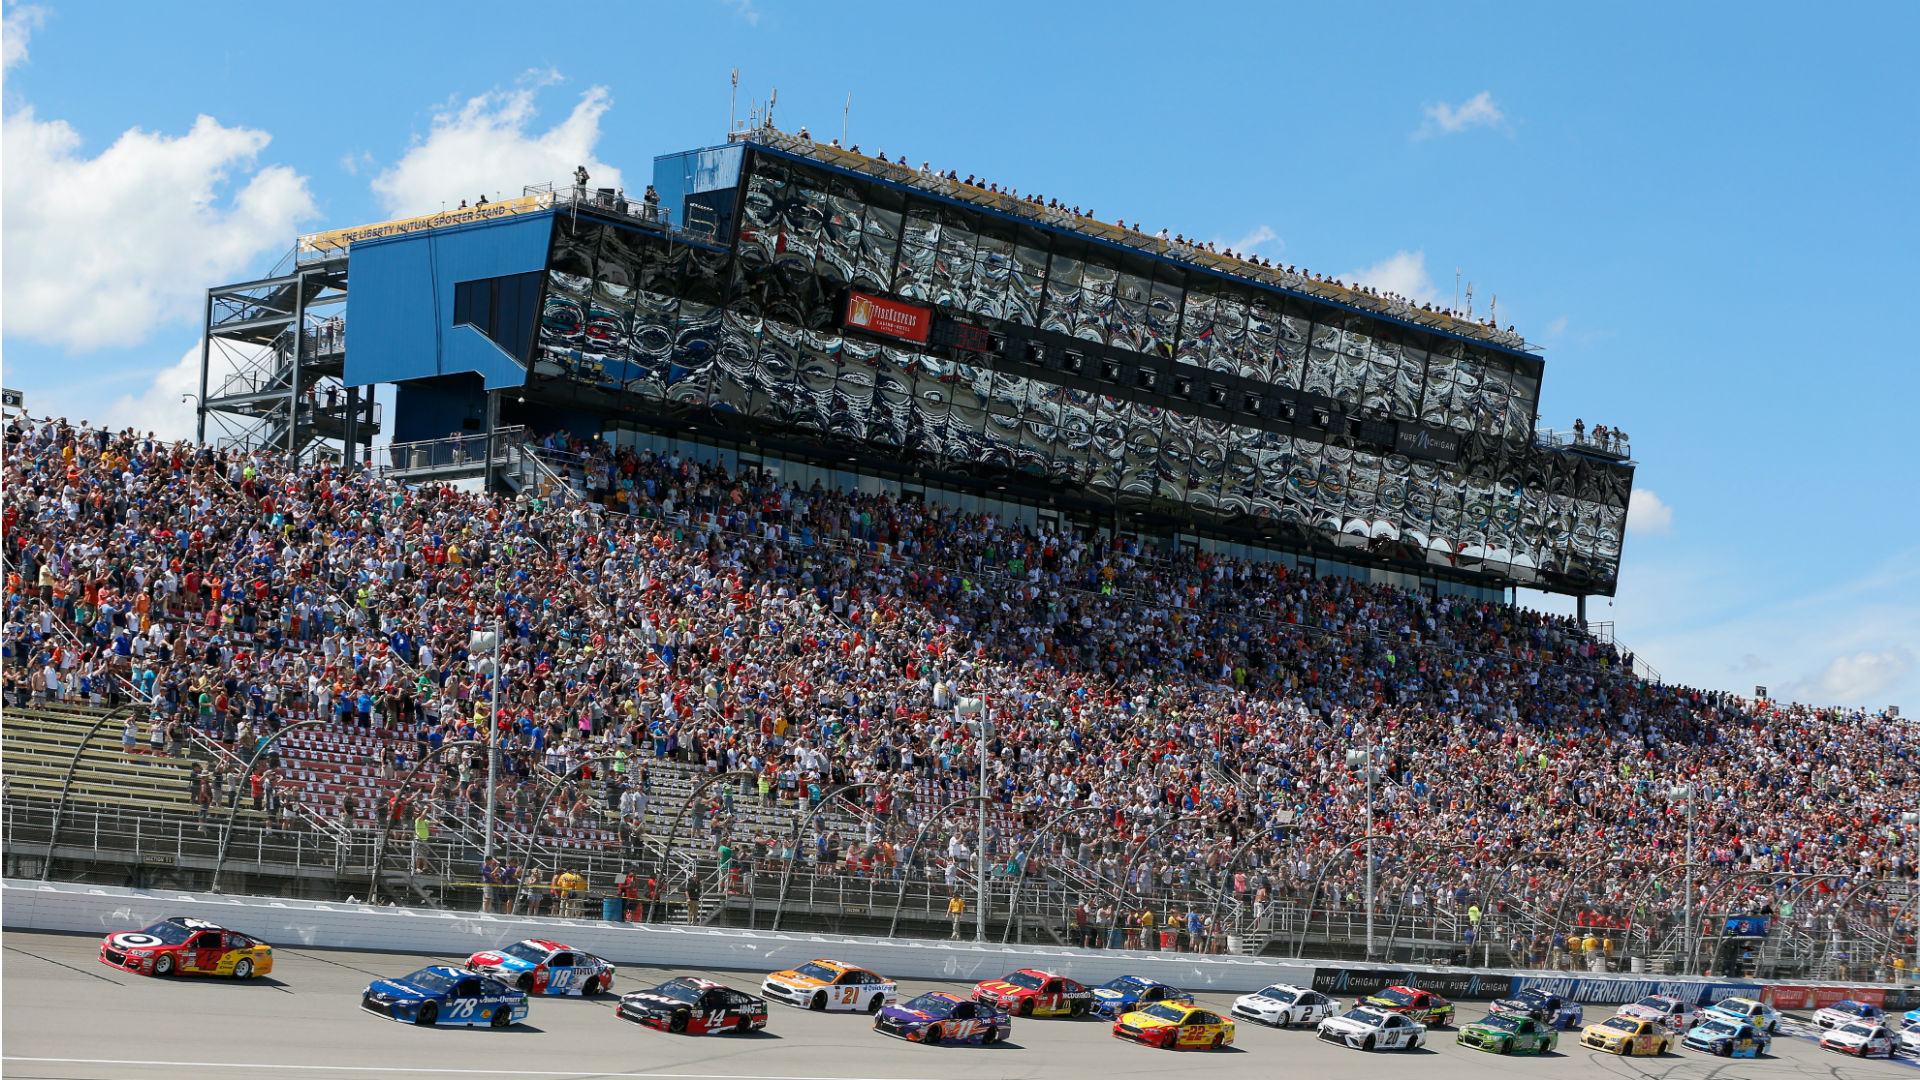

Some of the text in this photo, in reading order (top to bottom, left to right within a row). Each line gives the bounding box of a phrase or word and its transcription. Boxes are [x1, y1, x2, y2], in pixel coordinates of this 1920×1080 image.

[341, 206, 506, 242] THE LIBERTY MUTUAL SPOTTER STAND
[999, 341, 1004, 350] 1
[1037, 350, 1044, 360] 2
[1075, 359, 1081, 368] 3
[1112, 368, 1118, 377] 4
[1149, 376, 1155, 385] 5
[1184, 384, 1190, 393] 6
[6, 396, 13, 404] 9
[1220, 392, 1226, 401] 7
[1254, 400, 1260, 409] 8
[1289, 408, 1295, 416] 9
[1320, 415, 1329, 424] 10
[1400, 430, 1456, 451] PURE MICHIGAN
[551, 969, 571, 988] 18
[1315, 975, 1335, 985] PURE
[1330, 969, 1379, 991] MICHIGAN
[1384, 972, 1445, 989] PURE MICHIGAN
[1450, 975, 1508, 995] PURE MICHIGAN
[841, 986, 859, 1004] 21
[1519, 978, 1706, 1004] MICHIGAN INTERNATIONAL SPEEDWAY
[449, 998, 478, 1018] 78
[1050, 994, 1058, 1011] 1
[704, 1009, 726, 1027] 14
[1300, 1006, 1313, 1021] 2
[1547, 1009, 1560, 1024] 5
[1674, 1015, 1683, 1028] 3
[956, 1020, 975, 1039] 11
[1186, 1025, 1206, 1041] 22
[1385, 1031, 1399, 1045] 20
